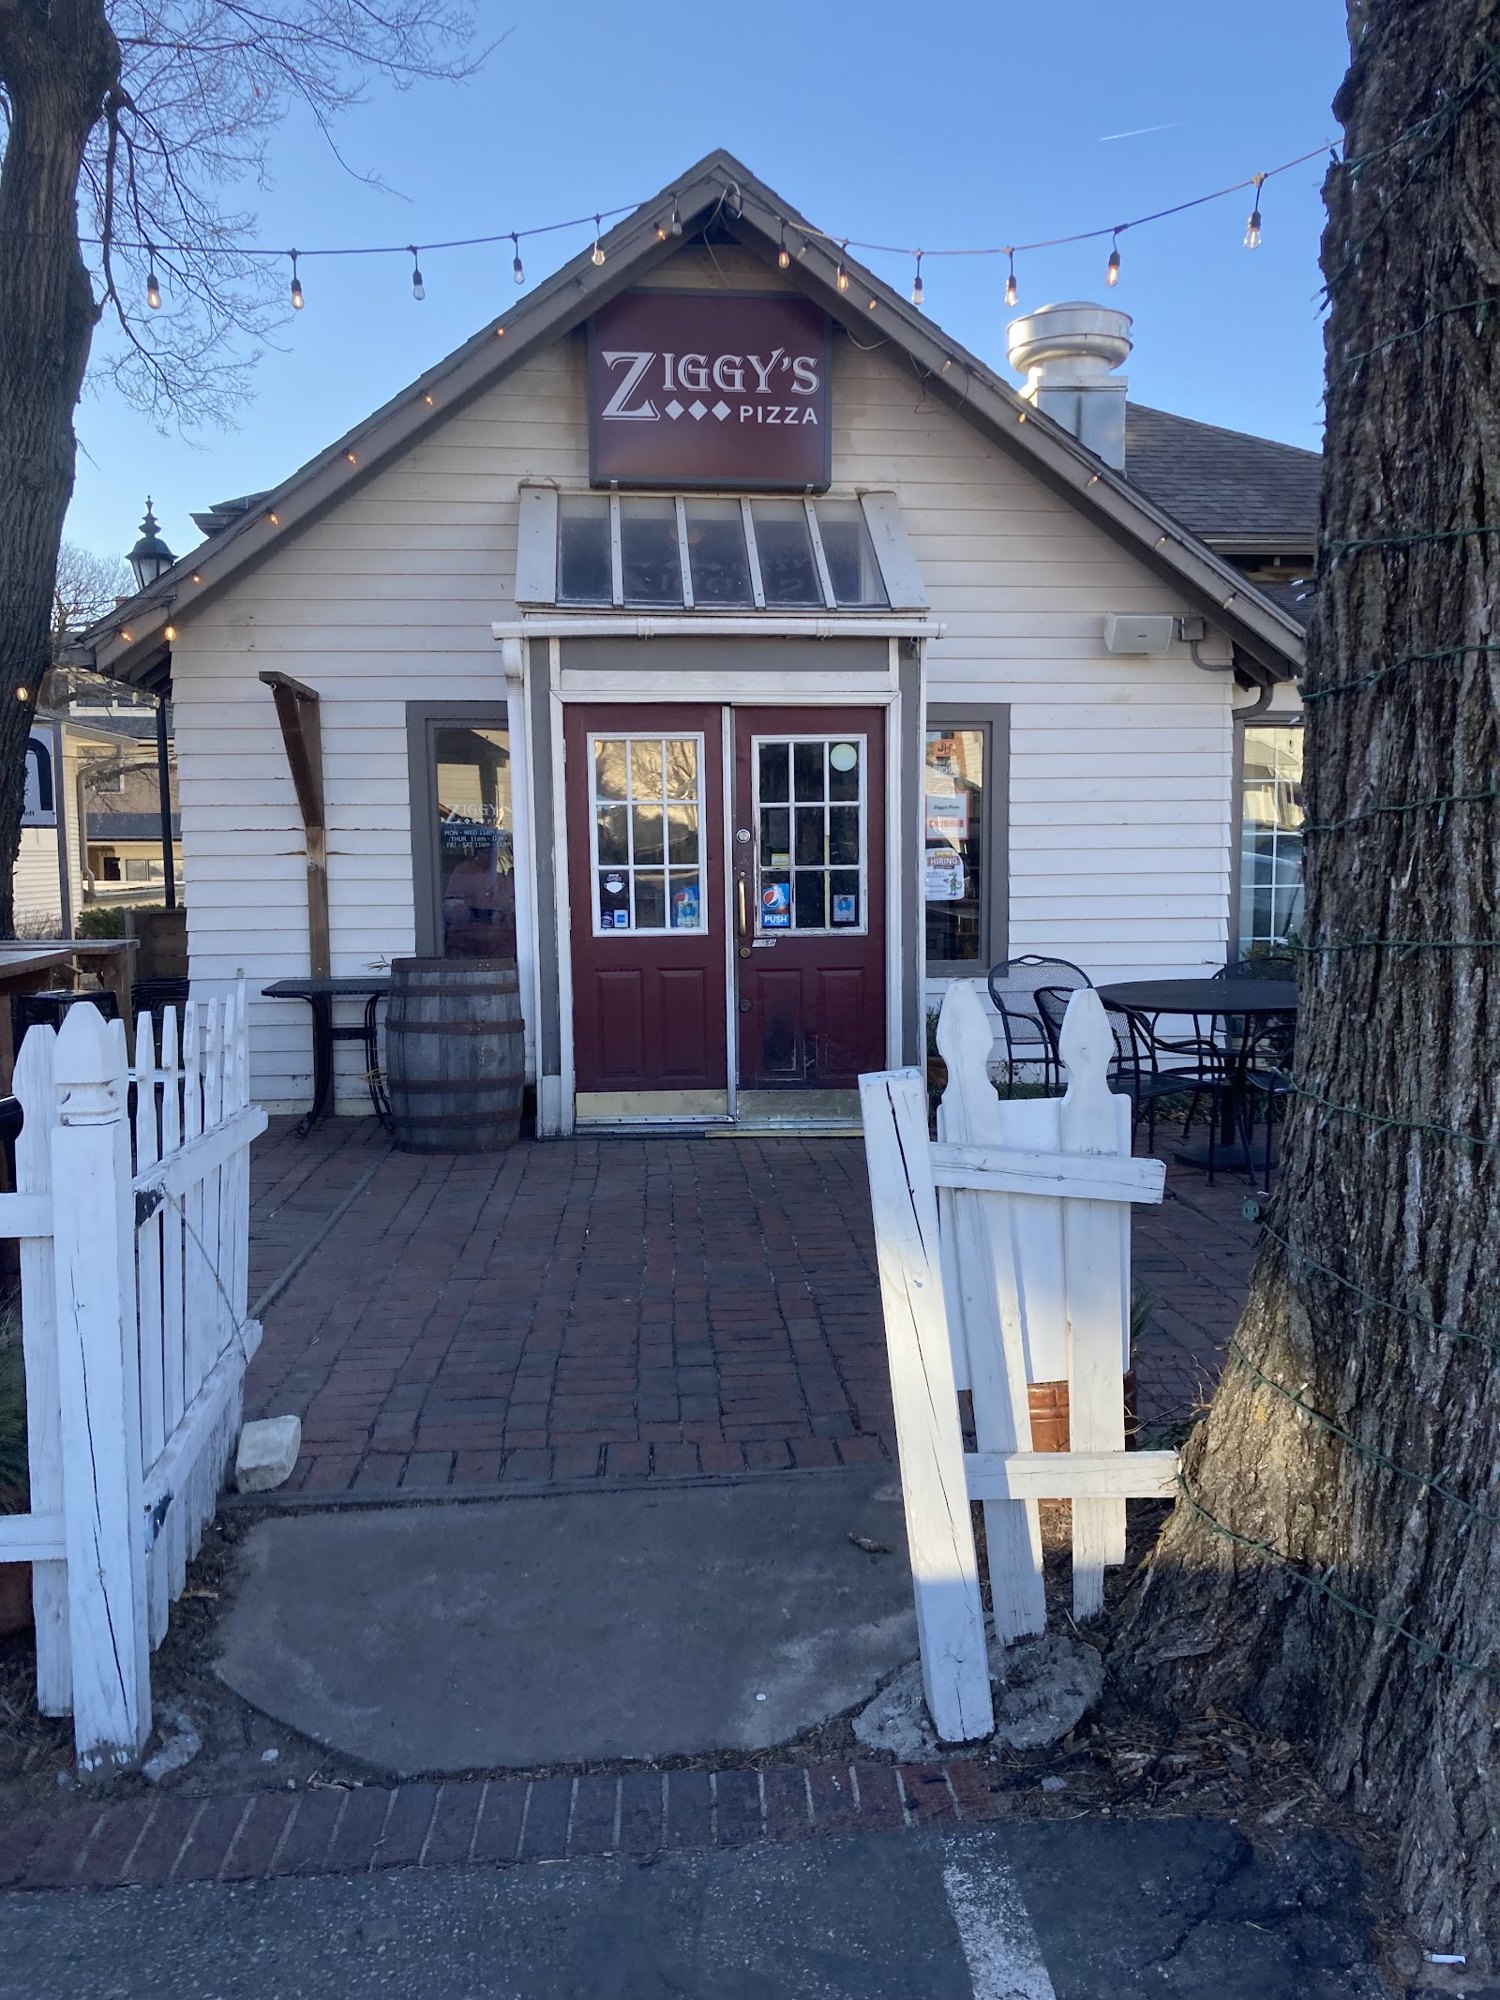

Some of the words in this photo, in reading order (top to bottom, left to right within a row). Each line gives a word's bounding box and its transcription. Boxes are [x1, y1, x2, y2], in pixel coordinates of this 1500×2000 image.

[601, 348, 820, 421] ZIGGY'S
[739, 405, 818, 425] PIZZA
[930, 857, 958, 865] HIRING
[764, 915, 788, 923] PUSH
